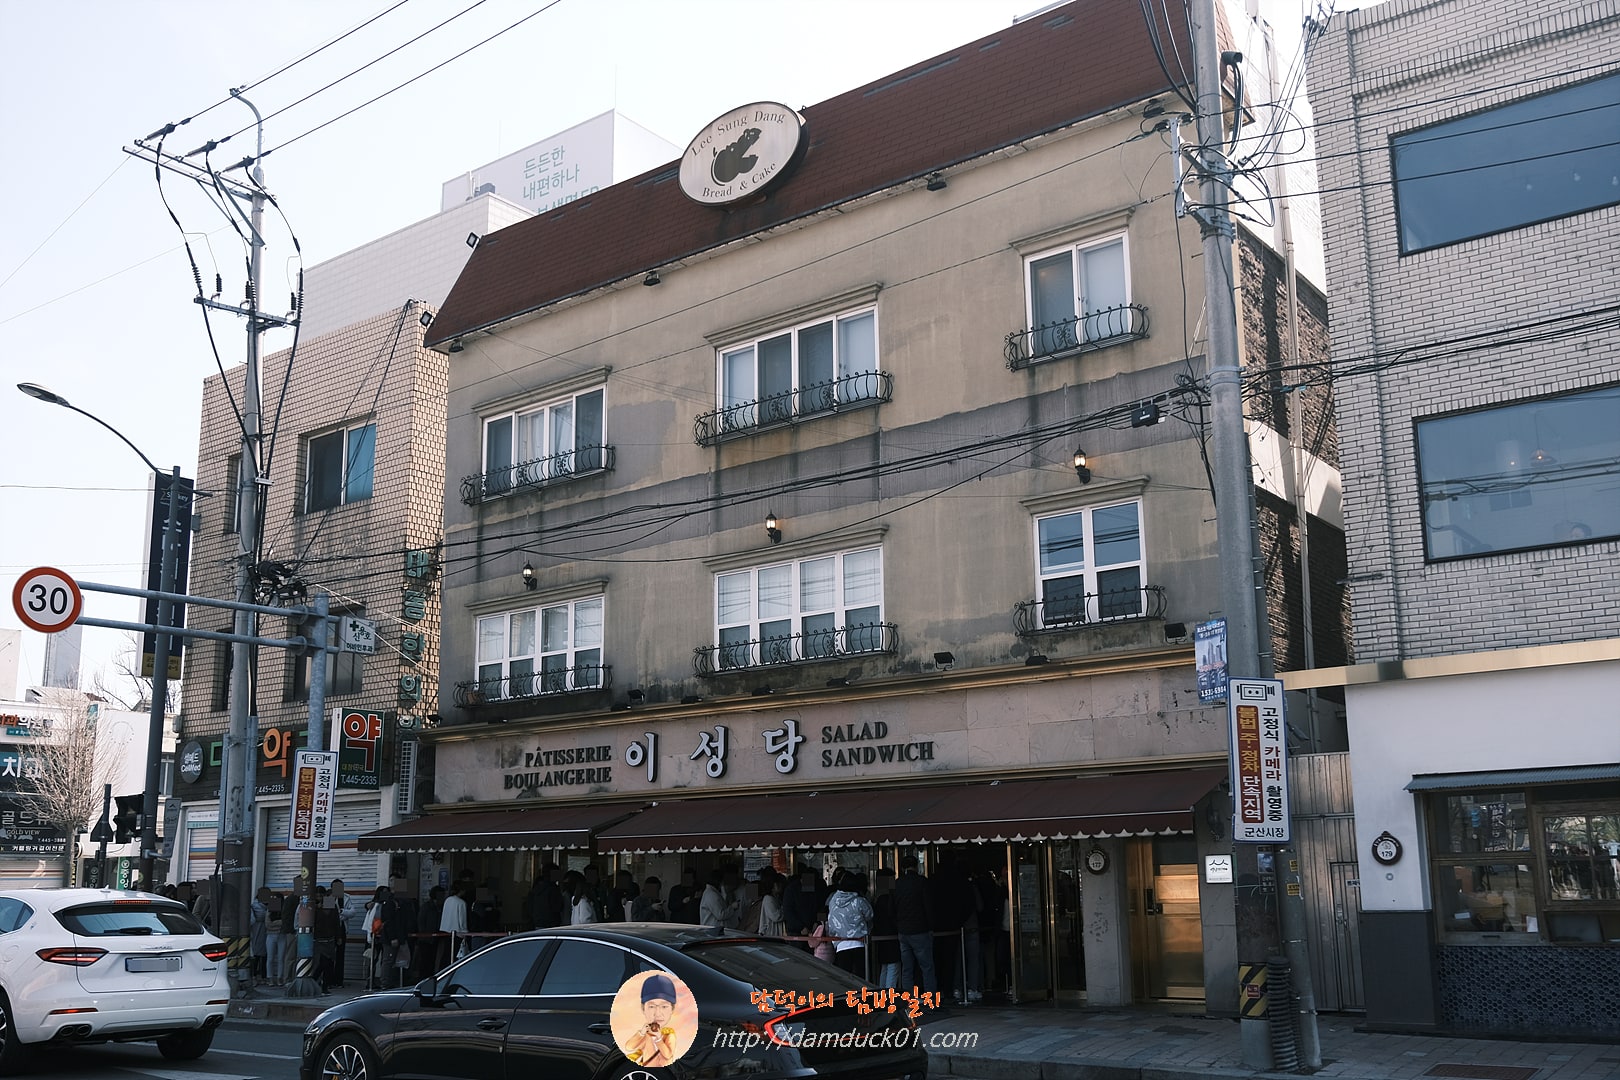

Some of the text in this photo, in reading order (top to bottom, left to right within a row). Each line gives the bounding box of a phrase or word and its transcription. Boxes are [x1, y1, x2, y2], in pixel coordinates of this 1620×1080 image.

[691, 111, 786, 156] Lee Sung Dang
[523, 145, 565, 179] 든든한
[702, 162, 777, 198] Bread & Cake
[28, 584, 68, 615] 30
[821, 721, 888, 744] SALAD
[1238, 707, 1257, 730] 불법
[343, 713, 381, 773] 약
[525, 745, 612, 768] PÂTISSERIE
[821, 741, 935, 768] SANDWICH
[504, 767, 612, 790] BOULANGERIE
[1262, 707, 1283, 822] 고정식 카메라 촬영중
[1242, 775, 1262, 821] 단속지역
[295, 840, 325, 848] 군산시장
[1244, 827, 1284, 838] 군산시장
